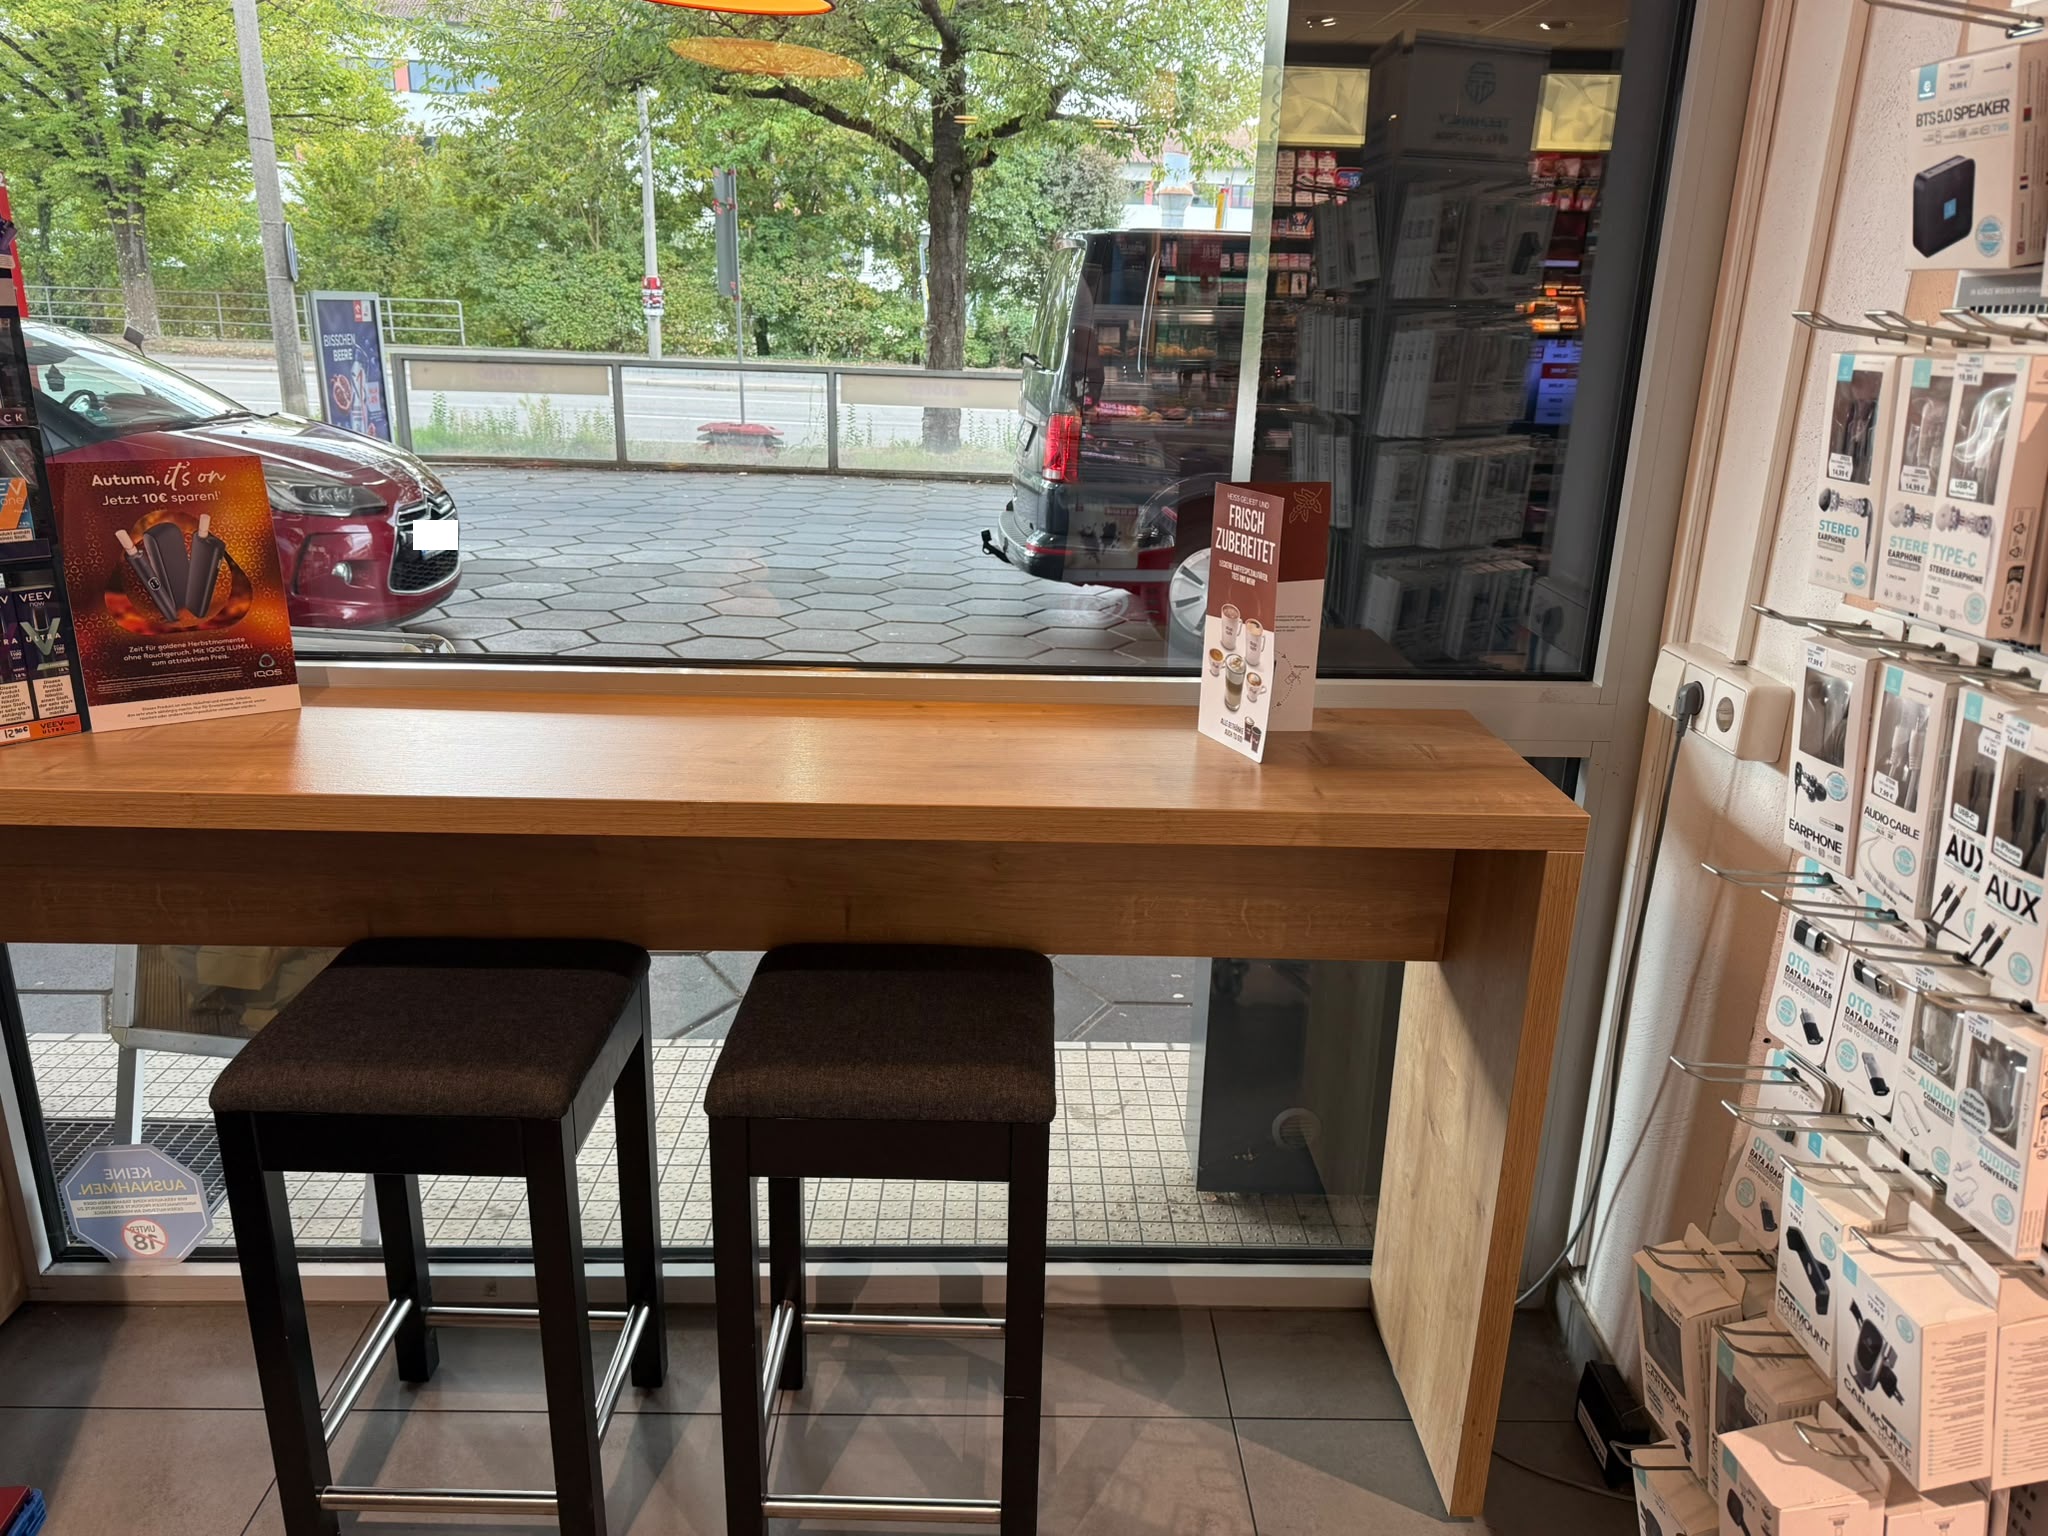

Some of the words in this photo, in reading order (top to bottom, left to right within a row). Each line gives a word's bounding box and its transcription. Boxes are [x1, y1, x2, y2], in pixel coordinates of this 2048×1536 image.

[1916, 111, 1936, 127] BTS
[1937, 108, 1953, 124] 5.0
[1953, 98, 2010, 121] SPEAKER
[323, 334, 356, 347] BISSCHEN
[333, 349, 353, 361] BEERE
[91, 474, 161, 487] Autumn,
[163, 461, 191, 491] it's
[197, 469, 227, 483] on
[1955, 481, 1974, 490] USB-C
[102, 495, 138, 506] Jetzt
[142, 492, 168, 504] 10€
[1229, 504, 1265, 535] FRISCH
[1819, 519, 1859, 538] STEREO
[1215, 527, 1276, 565] ZUBEREITET
[1818, 532, 1846, 545] EARPHONE
[1889, 535, 1929, 555] STERE
[1887, 549, 1922, 563] EARPHONE
[1932, 543, 1977, 568] TYPE-C
[1929, 564, 1950, 577] STEREO
[1950, 569, 1984, 584] EARPHONE
[19, 591, 52, 602] VEEV
[25, 632, 61, 643] ULTRA
[158, 643, 187, 652] goldene
[187, 637, 245, 647] Herbstmomente
[143, 650, 191, 659] Rauchgeruch.
[168, 656, 210, 665] attraktiven
[254, 668, 283, 678] IQOS
[40, 720, 64, 729] VEEV
[1864, 806, 1889, 826] AUDIO
[1889, 818, 1920, 840] CABLE
[1789, 818, 1843, 854] EARPHONE
[1985, 873, 2041, 924] AUX
[1788, 951, 1810, 975] OTG
[1785, 964, 1803, 980] DATA
[1802, 976, 1833, 1000] ADAPTER
[1847, 991, 1873, 1018] OTG
[1845, 1006, 1863, 1023] DATA
[1864, 1019, 1899, 1047] ADAPTER
[1917, 1050, 1935, 1067] USB-C
[1923, 1091, 1955, 1118] CONVERTE
[1753, 1136, 1774, 1163] OTG
[1750, 1148, 1766, 1167] DATA
[1764, 1160, 1785, 1183] ADAP
[1977, 1145, 2021, 1185] AUDIOE
[1979, 1159, 2018, 1193] CONVERTER
[1795, 1309, 1830, 1351] MOUNT
[1843, 1377, 1866, 1411] CAR
[1865, 1407, 1912, 1456] MOUNT
